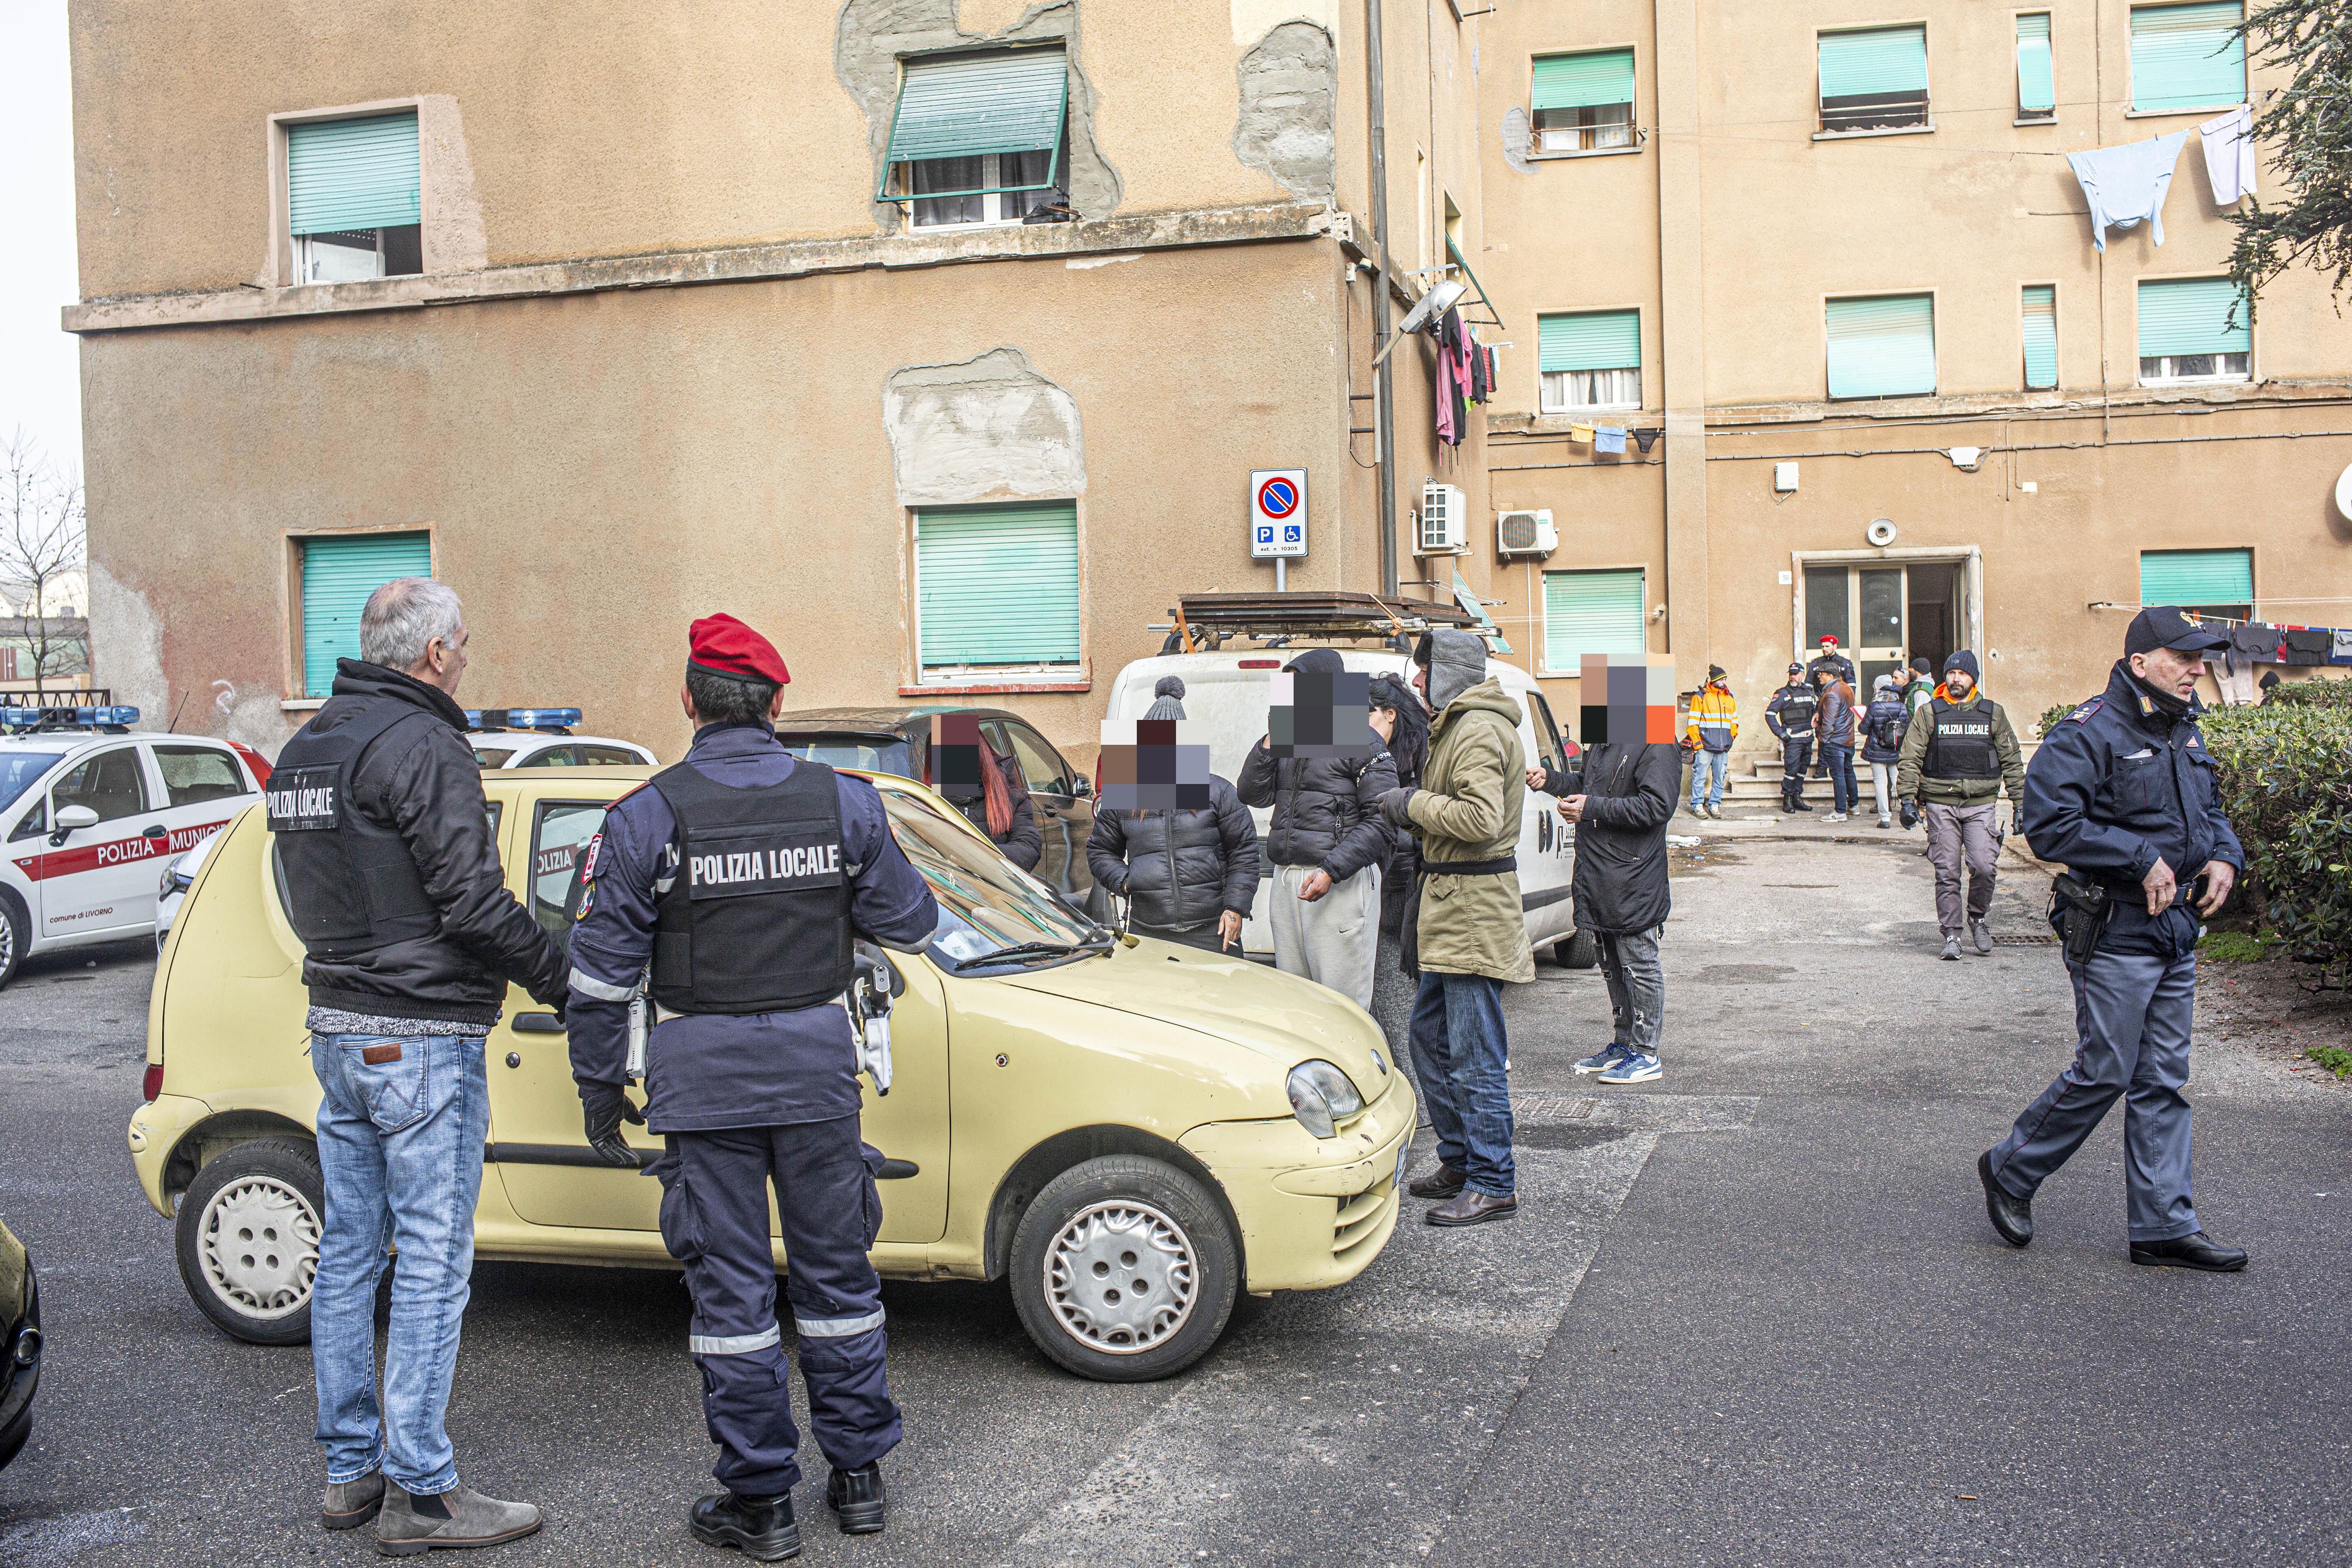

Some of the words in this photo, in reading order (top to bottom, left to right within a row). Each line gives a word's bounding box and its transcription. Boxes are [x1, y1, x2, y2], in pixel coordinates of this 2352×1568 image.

[1261, 529, 1270, 541] P
[1938, 724, 1963, 735] POLIZIA
[1964, 724, 1989, 735] LOCALE
[267, 790, 297, 818] POLIZIA
[298, 787, 333, 817] LOCALE
[97, 837, 155, 865] POLIZIA
[690, 851, 764, 886] POLIZIA
[769, 844, 839, 879] LOCALE
[50, 914, 76, 923] comune
[85, 907, 113, 918] LIVORNO
